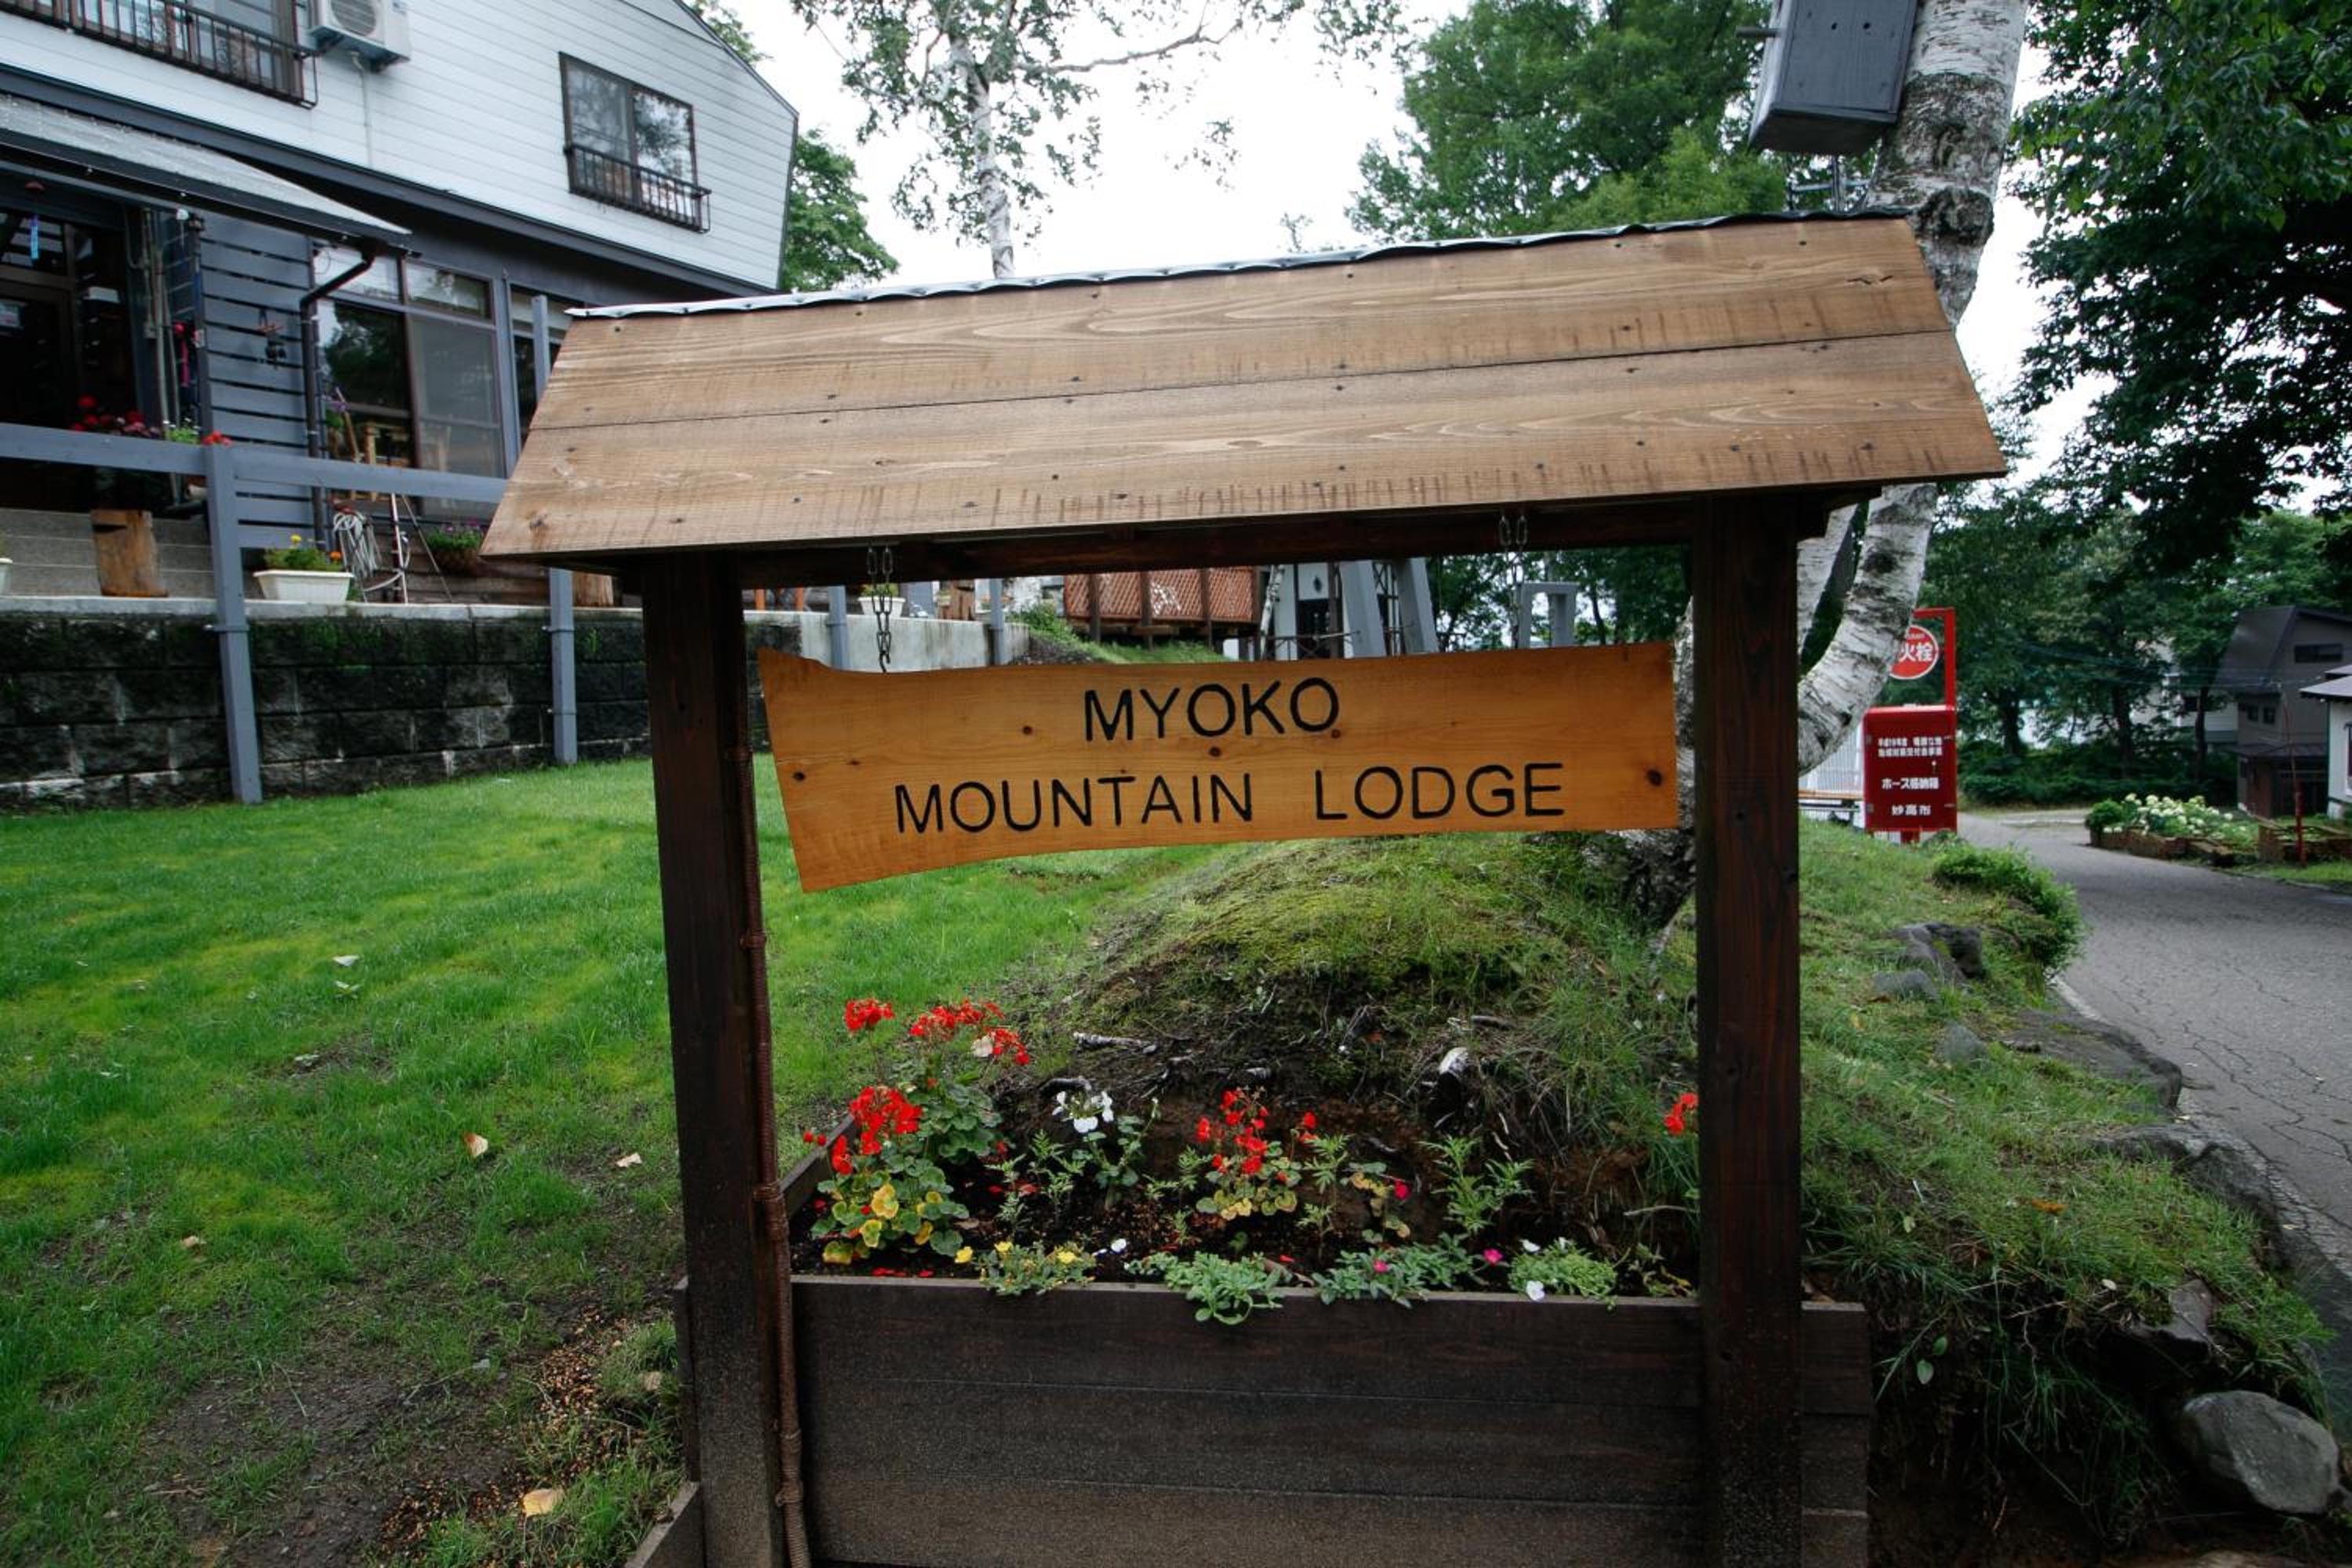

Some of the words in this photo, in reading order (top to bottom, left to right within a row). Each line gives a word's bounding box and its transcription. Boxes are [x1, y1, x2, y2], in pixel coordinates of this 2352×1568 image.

[1898, 642, 1933, 662] 火栓
[1085, 677, 1338, 740] MYOKO
[896, 774, 1252, 833] MOUNTAIN
[1316, 763, 1563, 819] LODGE
[1892, 804, 1931, 815] 妙高市
